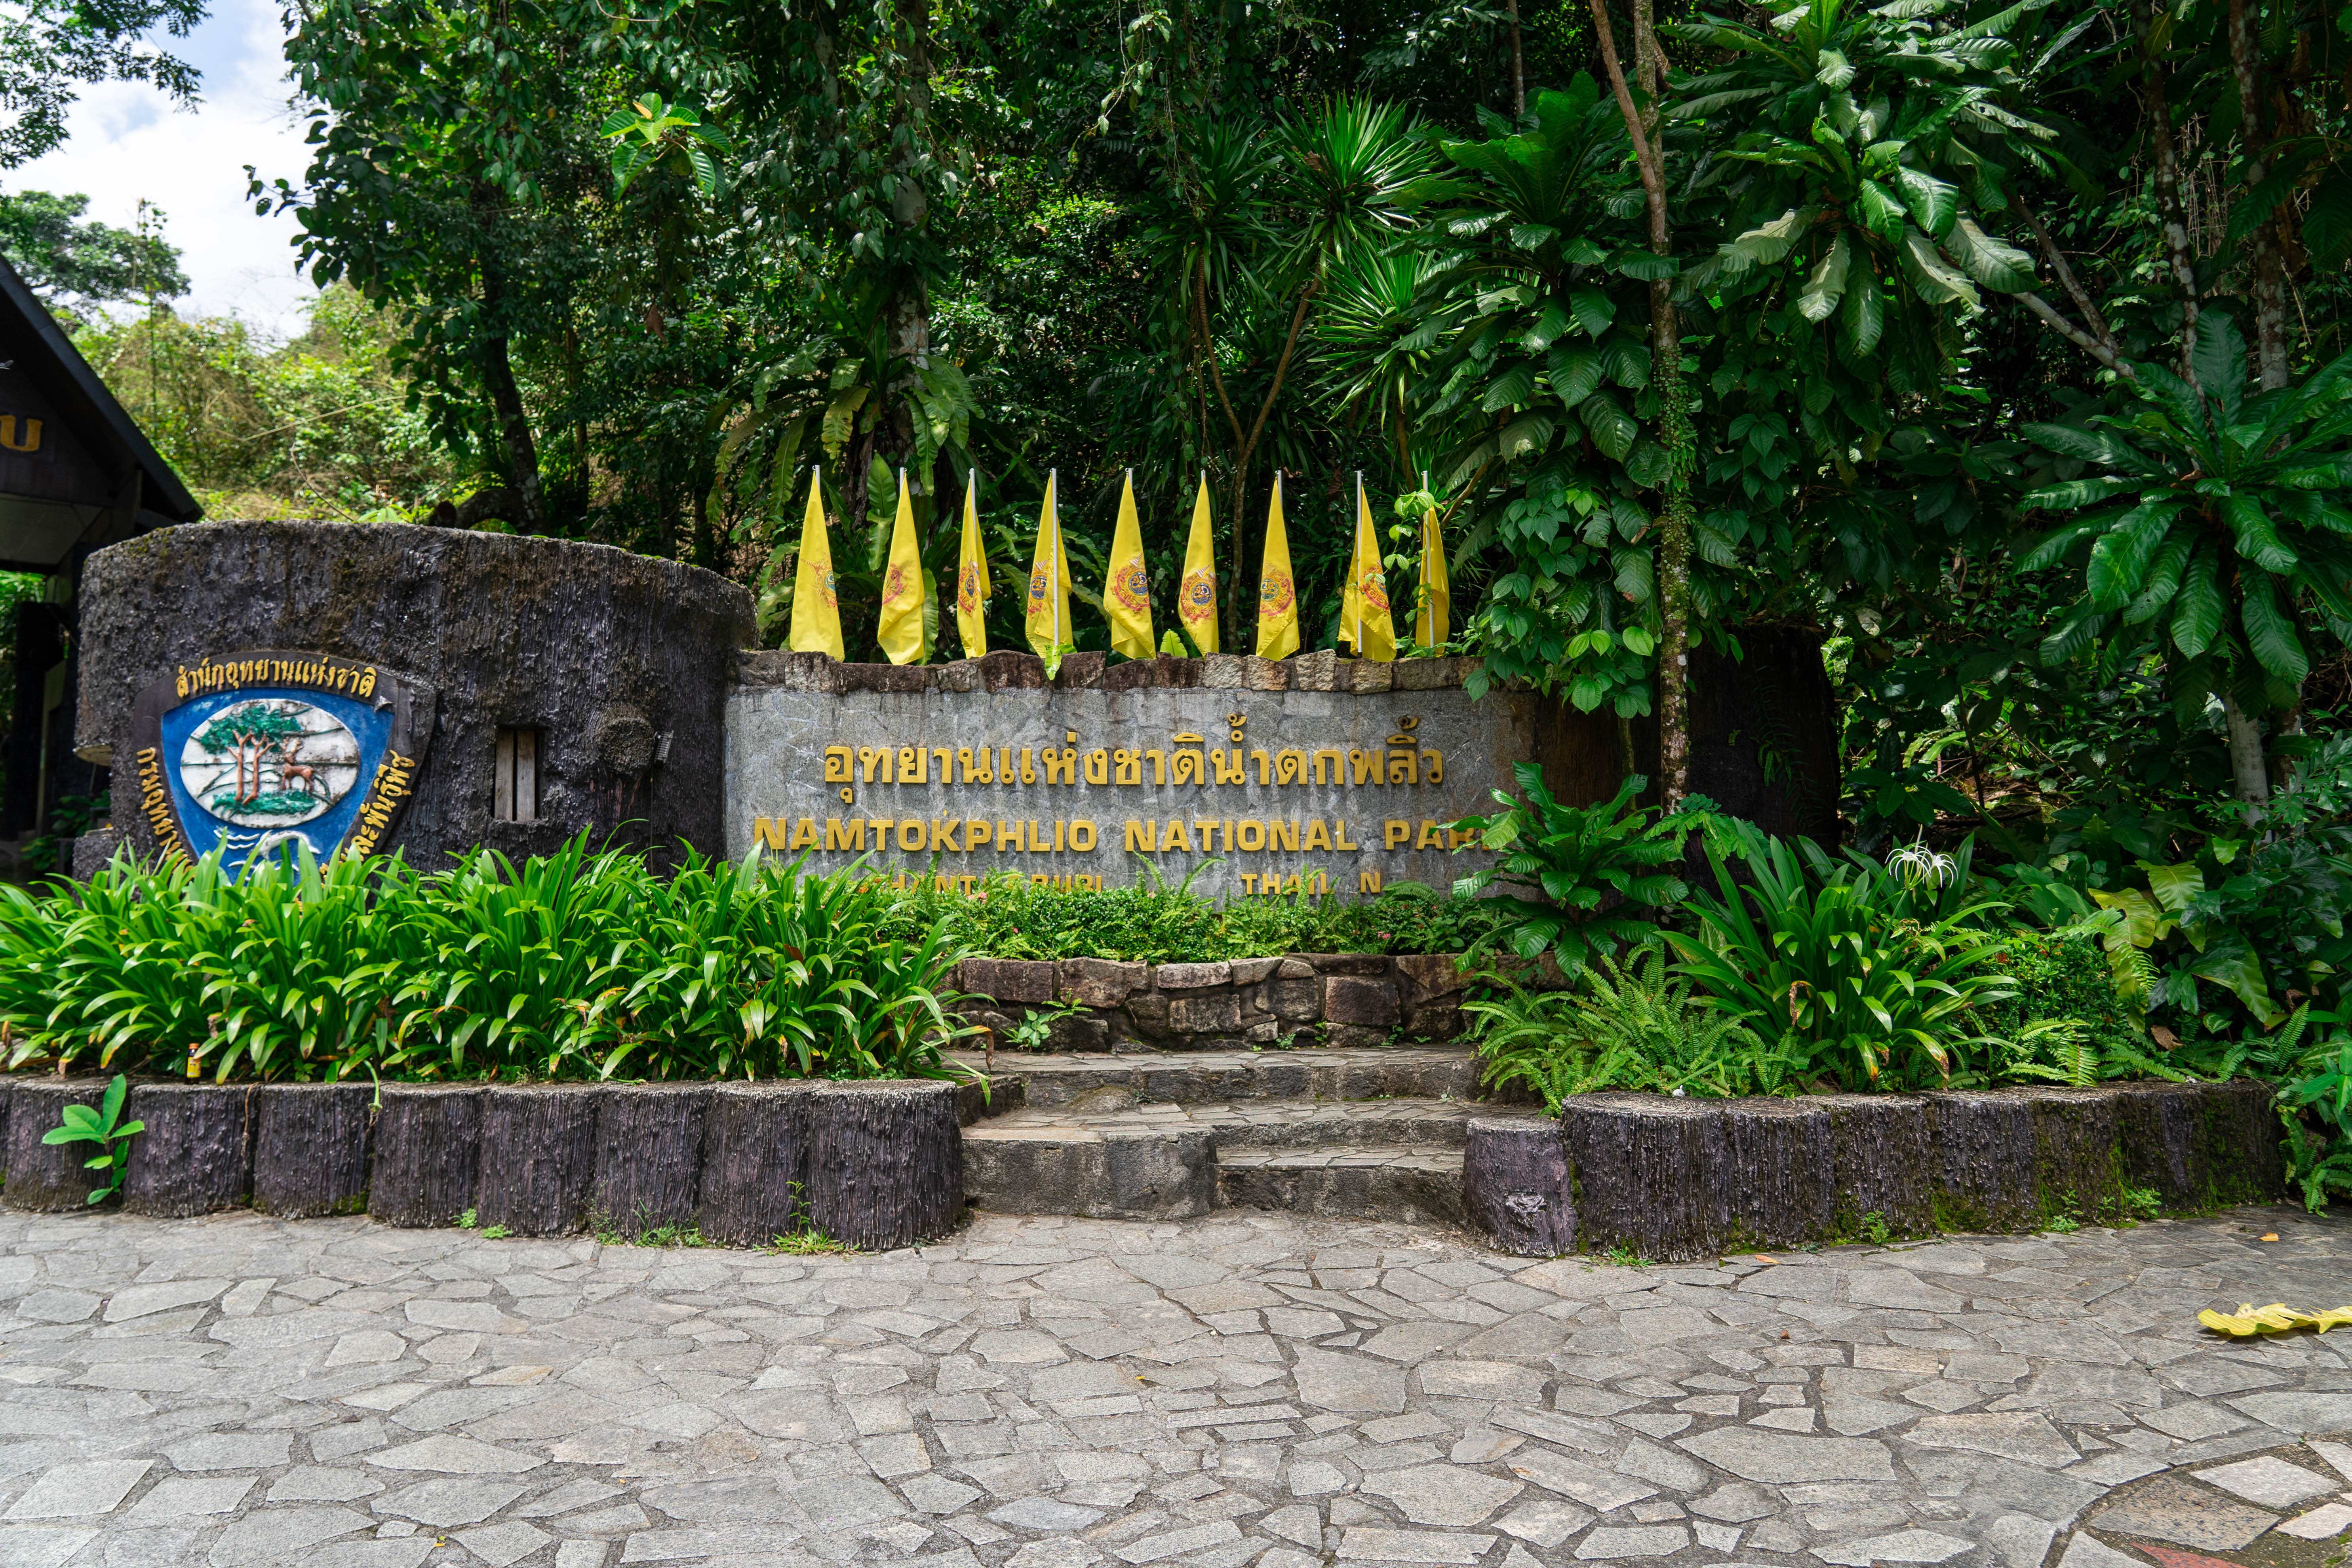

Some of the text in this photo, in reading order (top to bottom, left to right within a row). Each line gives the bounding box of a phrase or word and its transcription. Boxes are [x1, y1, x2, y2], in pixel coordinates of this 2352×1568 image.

[175, 657, 377, 698] สำนักอุทยานแห่งชาติ
[824, 714, 1444, 803] อุทยานแห่งชาติน้ำตกพลิ้ว
[754, 817, 1097, 852] NAMTOKPHLIO
[1125, 820, 1357, 852] NATIONAL
